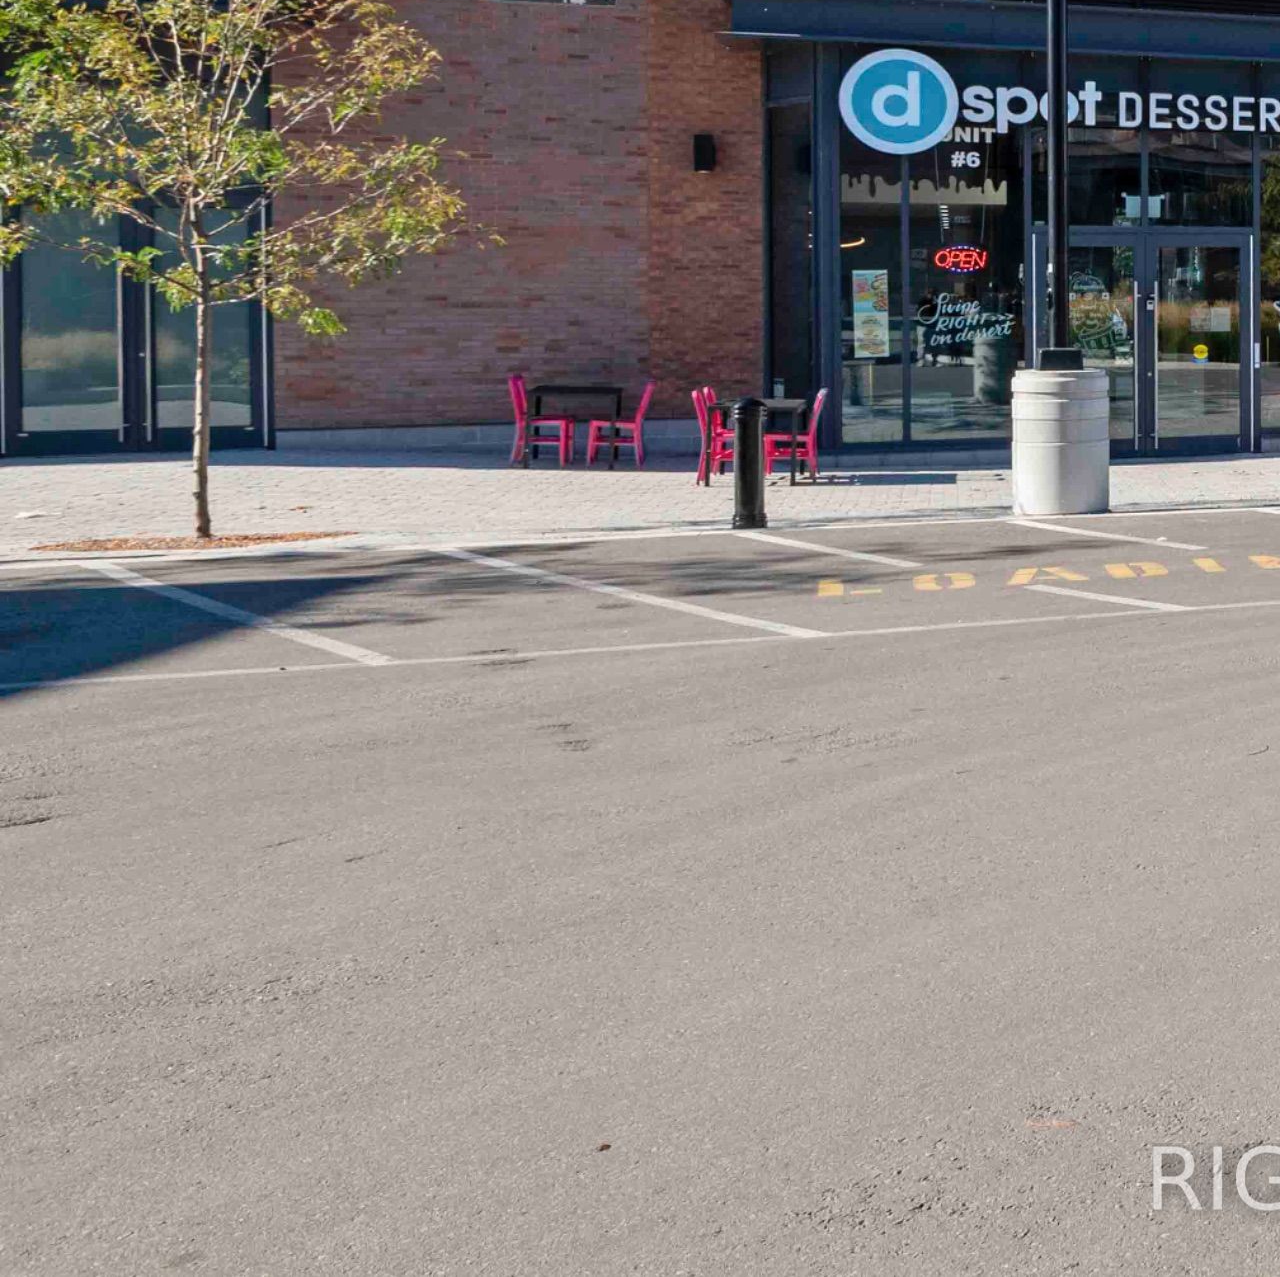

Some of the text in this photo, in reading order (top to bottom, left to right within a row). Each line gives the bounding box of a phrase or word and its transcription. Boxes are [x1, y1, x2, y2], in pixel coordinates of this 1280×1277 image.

[871, 71, 920, 127] d
[950, 151, 981, 168] #6
[935, 250, 987, 268] OPEN
[935, 313, 988, 331] RIGHT
[955, 322, 1016, 342] dessert
